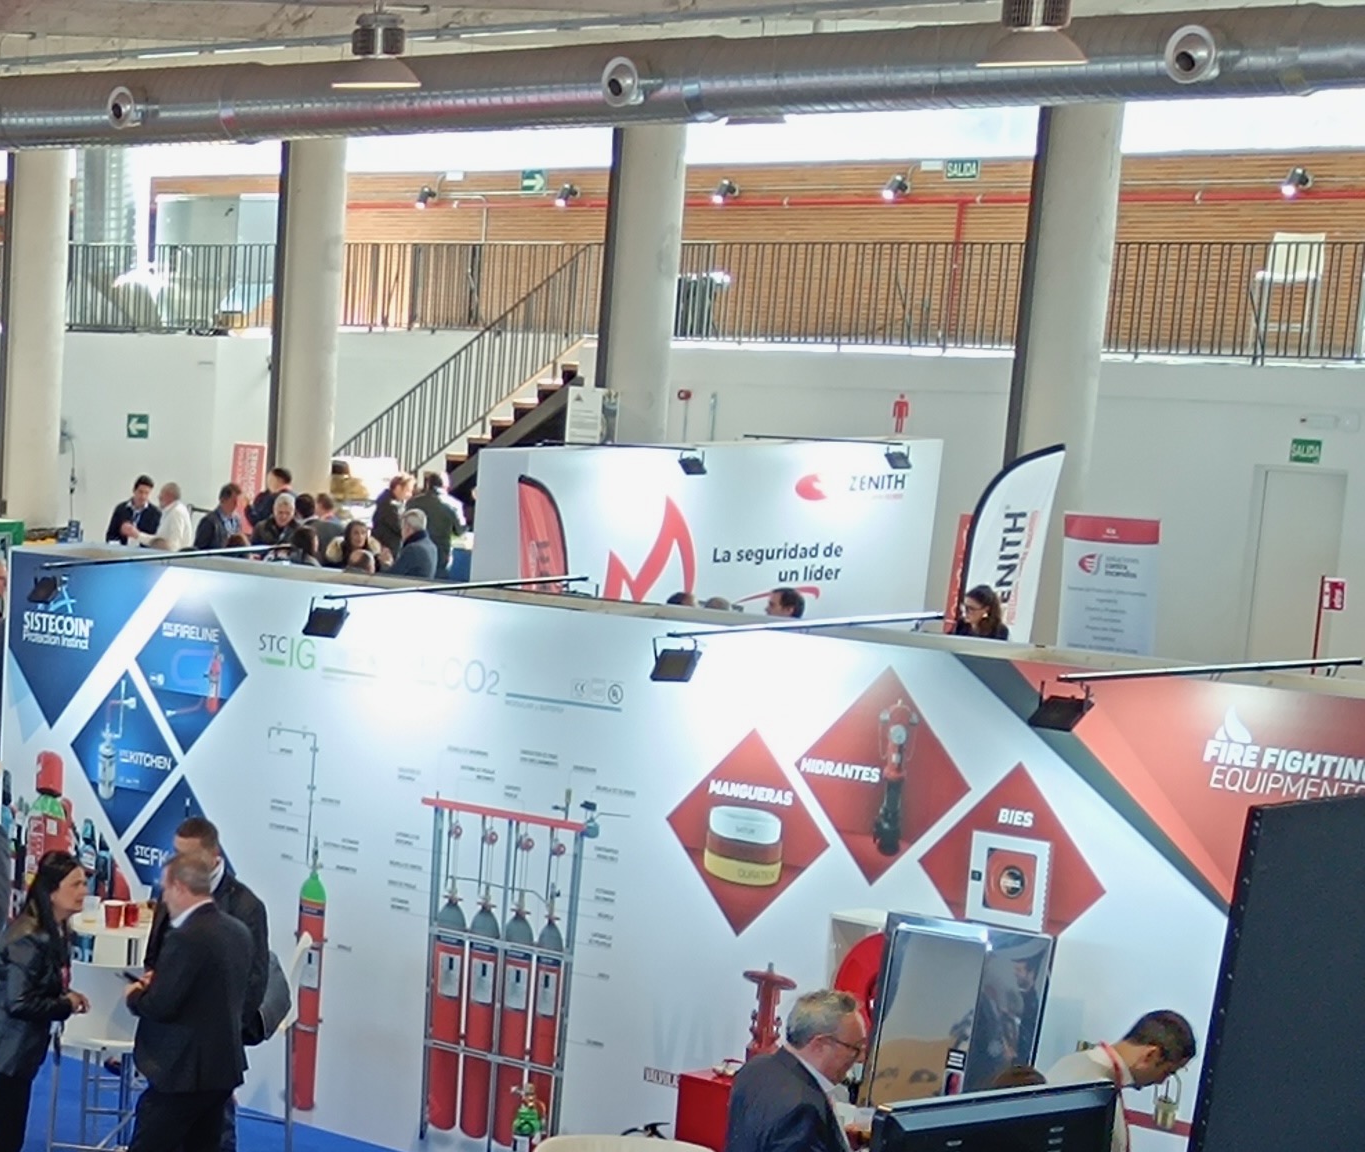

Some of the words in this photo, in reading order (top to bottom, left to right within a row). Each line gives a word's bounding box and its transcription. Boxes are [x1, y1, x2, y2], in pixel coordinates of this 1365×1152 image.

[948, 162, 976, 177] SALIDA
[1291, 442, 1319, 456] SALIDA
[849, 474, 906, 491] ZENITH
[713, 548, 731, 564] La
[737, 542, 819, 566] seguridad
[823, 541, 844, 559] de
[995, 511, 1027, 604] ENITH
[778, 569, 798, 582] un
[803, 566, 840, 581] líder
[24, 611, 90, 638] SISTECOIN
[174, 623, 220, 643] FIRELINE
[23, 631, 58, 647] Protection
[60, 635, 89, 650] Instinct
[259, 633, 287, 653] STC
[289, 638, 316, 670] IG
[129, 754, 171, 771] KITCHEN
[801, 757, 880, 783] HIDRANTES
[1203, 740, 1261, 768] FIRE
[1261, 747, 1365, 782] FIGHTIN
[709, 779, 793, 806] MANGUERAS
[997, 808, 1034, 827] BIES
